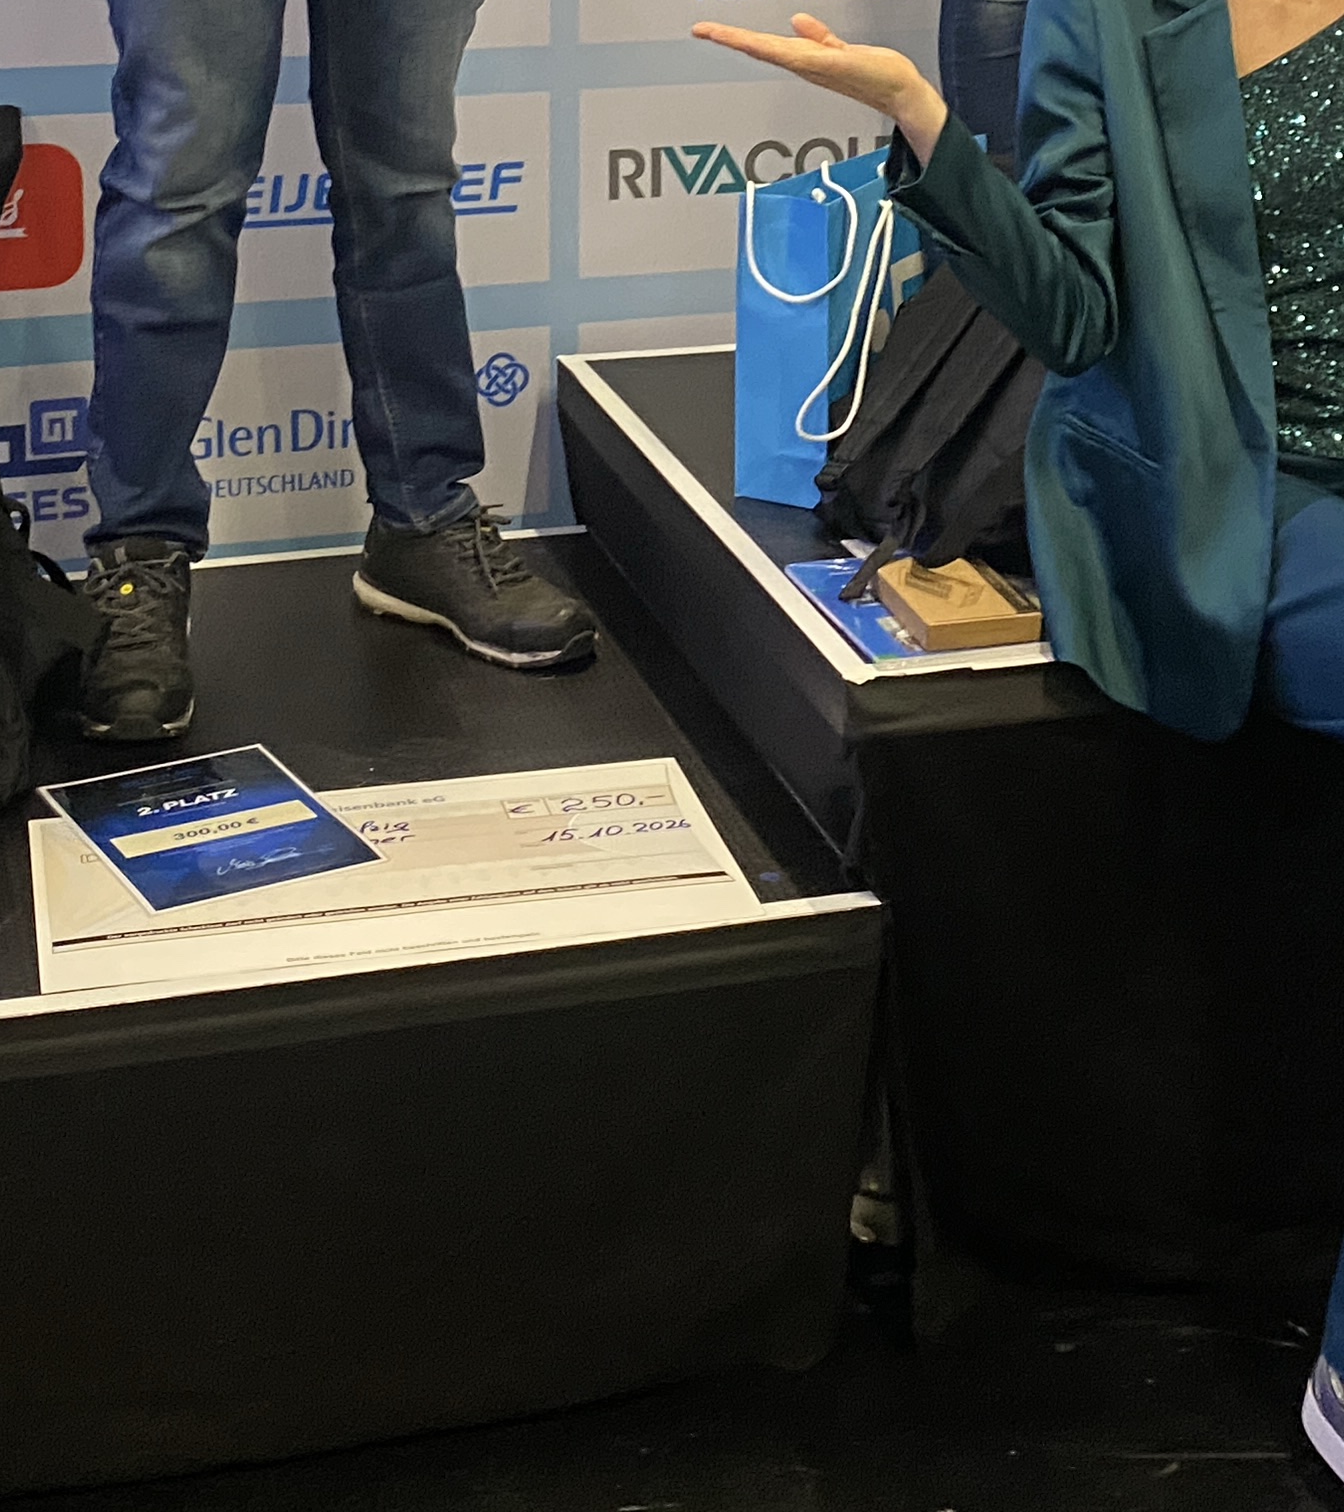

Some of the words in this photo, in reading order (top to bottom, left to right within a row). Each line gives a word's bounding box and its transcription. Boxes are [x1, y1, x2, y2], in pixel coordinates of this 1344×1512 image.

[208, 468, 355, 499] EUTSCHLAND
[137, 805, 160, 817] 2.
[162, 787, 240, 811] PLATZ
